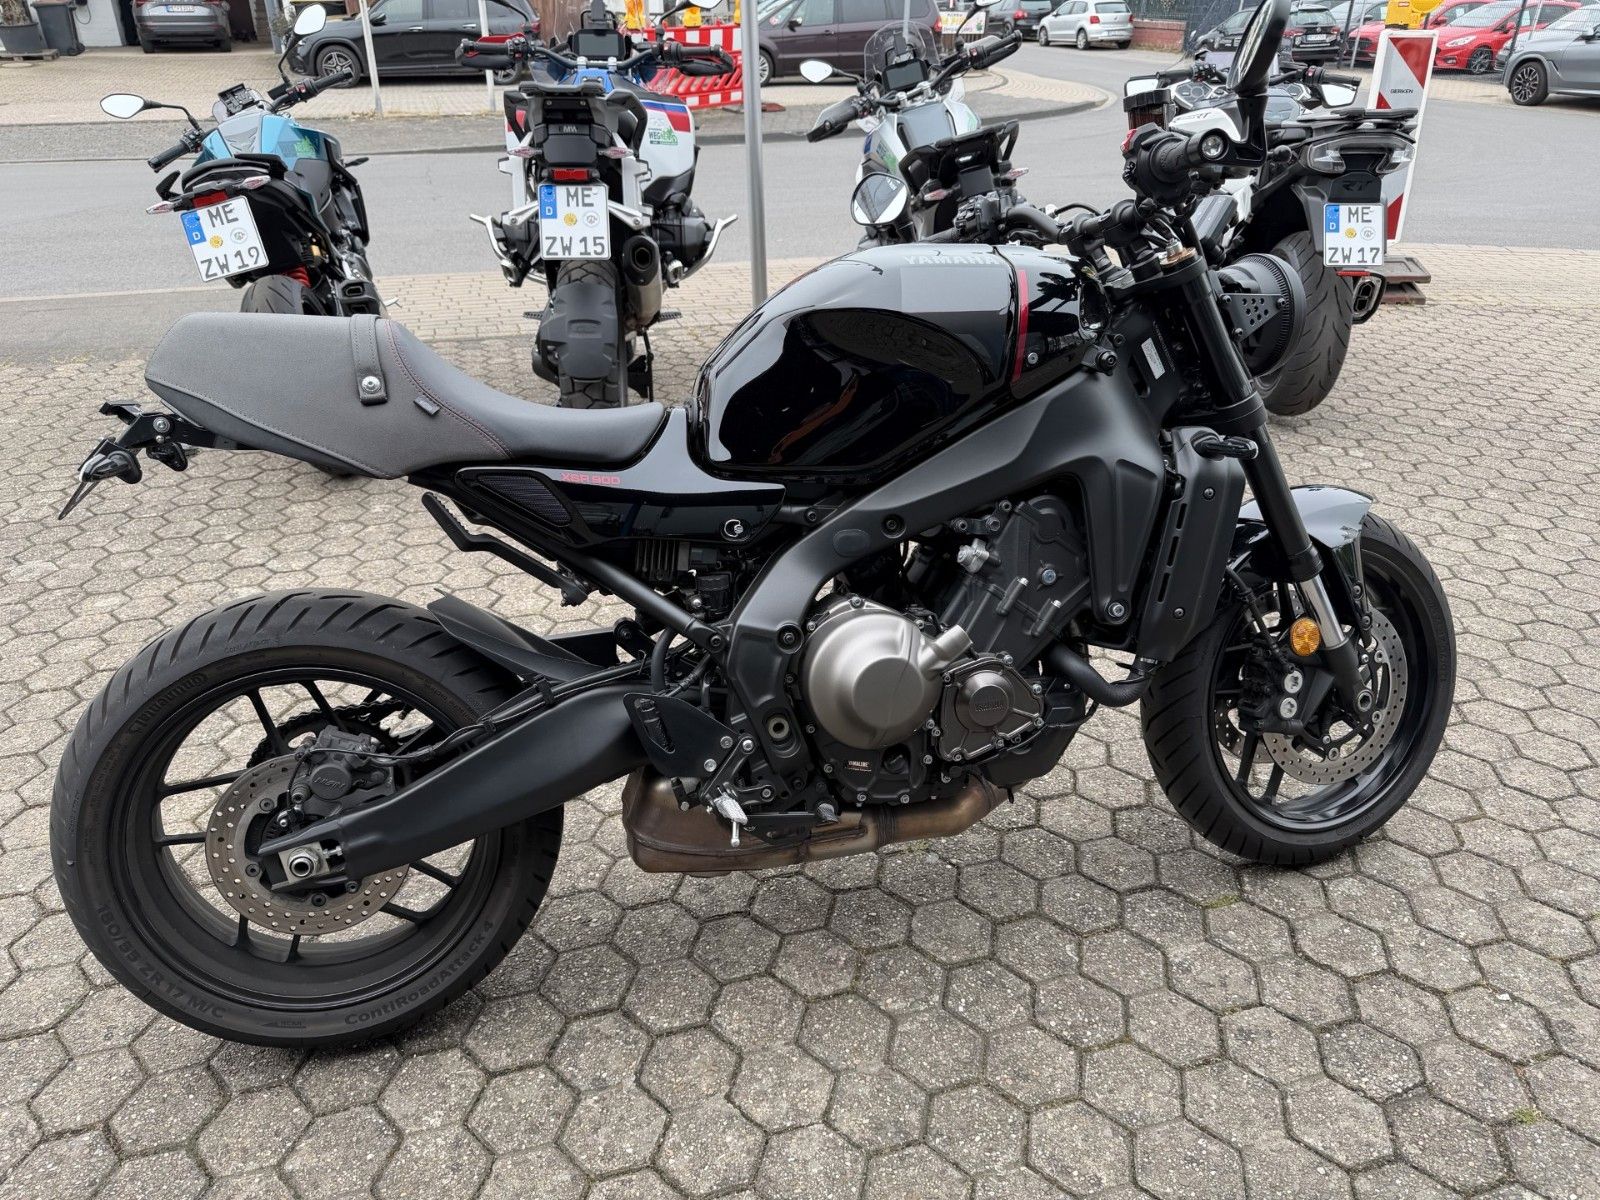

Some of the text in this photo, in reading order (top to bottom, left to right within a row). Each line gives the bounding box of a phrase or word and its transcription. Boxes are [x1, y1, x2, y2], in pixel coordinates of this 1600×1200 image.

[566, 187, 594, 207] ME
[207, 203, 239, 228] ME
[545, 206, 553, 216] D
[1347, 206, 1372, 223] ME
[1329, 222, 1336, 230] D
[192, 231, 201, 241] D
[545, 236, 605, 256] ZW 15
[200, 246, 260, 278] ZW 19
[904, 255, 1003, 265] YAMAHA
[1328, 247, 1380, 264] ZW 17
[591, 475, 621, 485] 900
[344, 920, 495, 1026] ContiRoadAttack 4
[137, 961, 165, 988] ZR
[165, 981, 184, 1000] 17
[187, 992, 227, 1019] M/C
